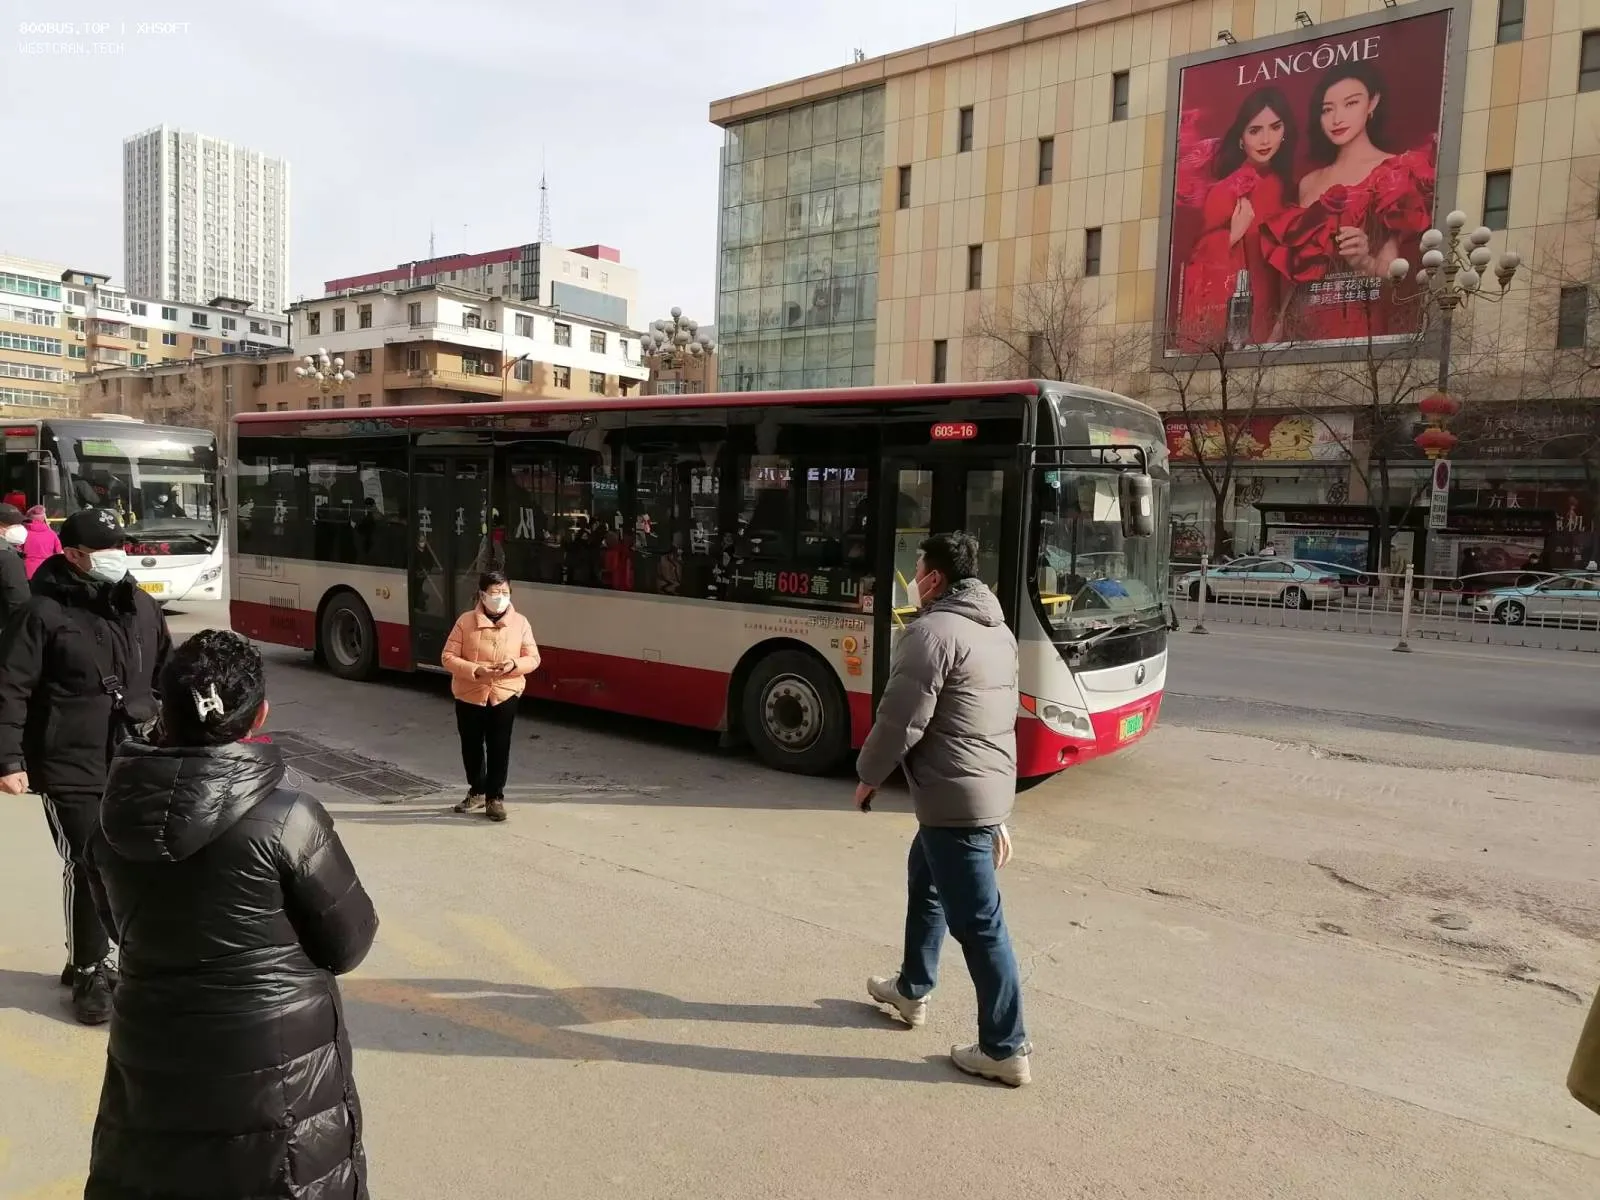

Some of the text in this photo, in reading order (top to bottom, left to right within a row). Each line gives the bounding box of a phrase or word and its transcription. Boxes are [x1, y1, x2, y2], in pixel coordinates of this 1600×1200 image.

[1236, 35, 1381, 87] LANCÔME
[934, 425, 973, 437] 603-16
[731, 569, 777, 591] 十一道街
[778, 571, 809, 594] 603
